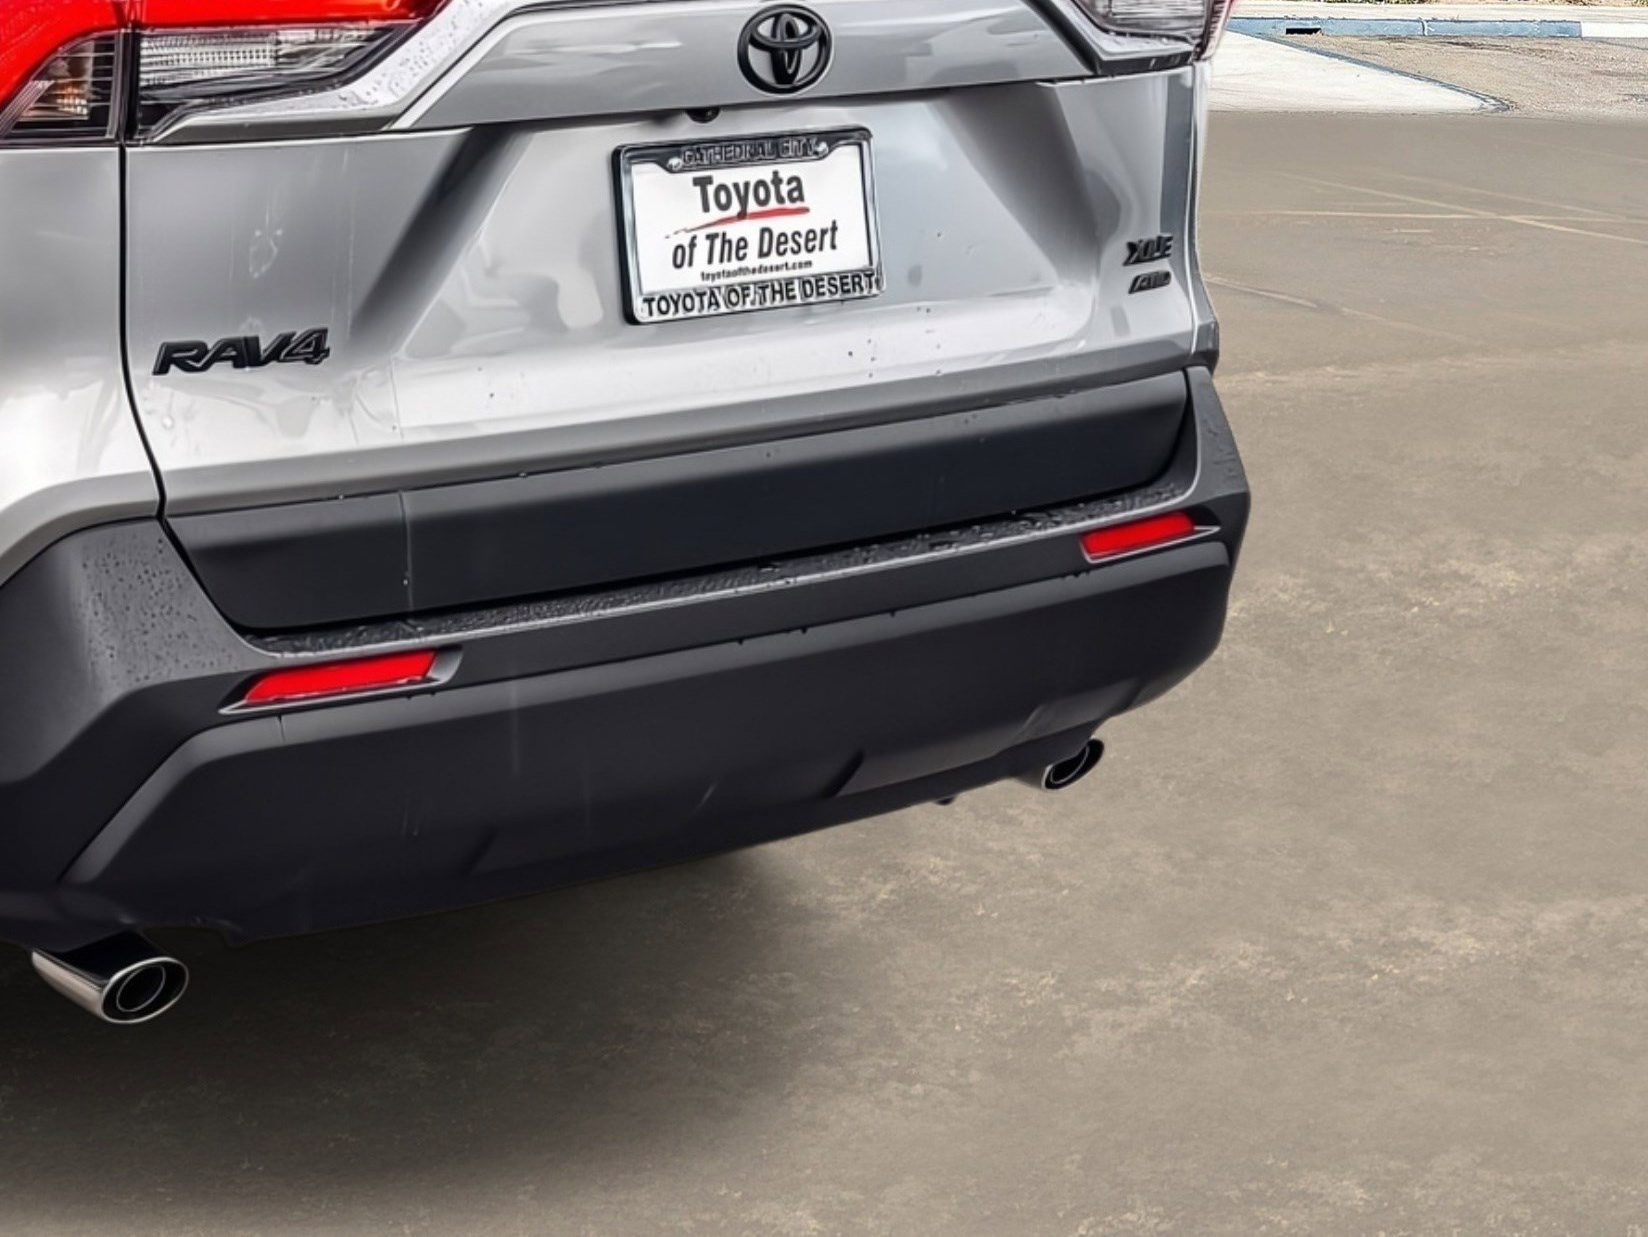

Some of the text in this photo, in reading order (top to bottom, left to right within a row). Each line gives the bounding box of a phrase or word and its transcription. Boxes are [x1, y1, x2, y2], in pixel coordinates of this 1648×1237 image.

[692, 170, 805, 219] Toyota
[672, 219, 838, 269] of The Desert
[642, 272, 875, 317] TOYOTA OF THE DESERT
[701, 260, 813, 282] toyotaofthedesert.com
[152, 327, 330, 376] RAV4
